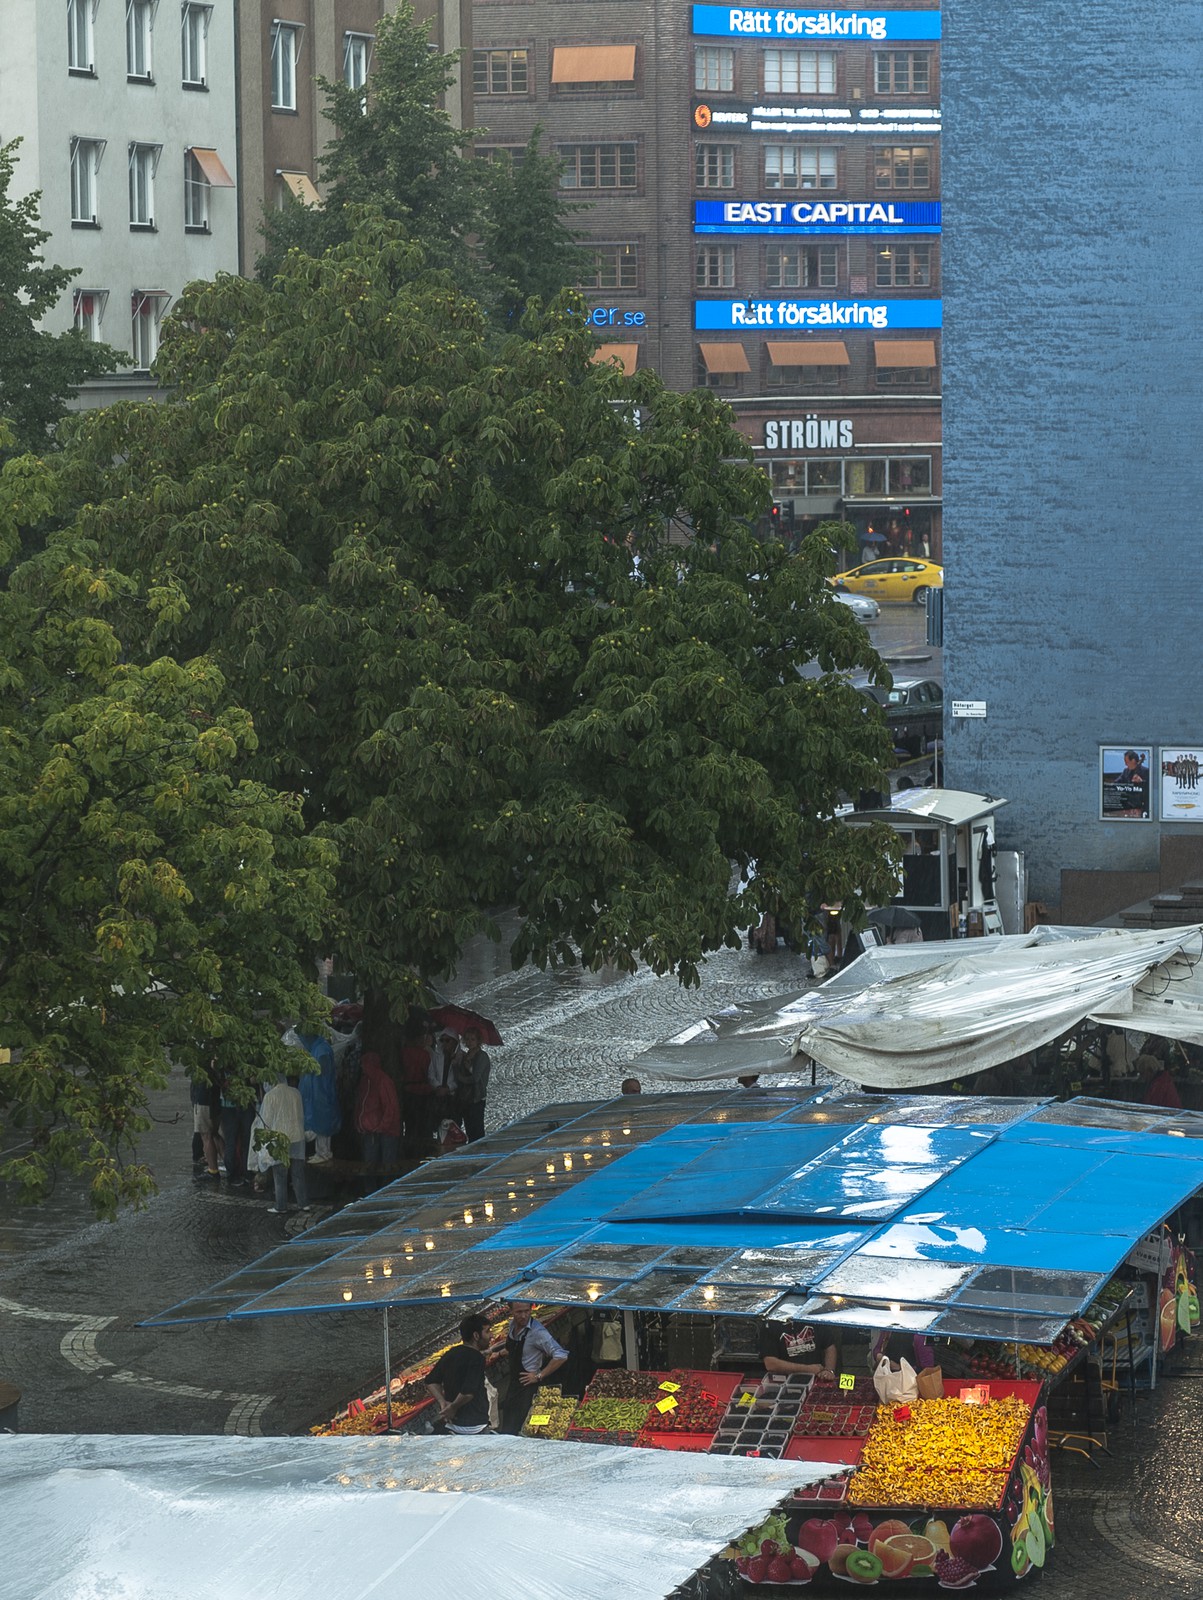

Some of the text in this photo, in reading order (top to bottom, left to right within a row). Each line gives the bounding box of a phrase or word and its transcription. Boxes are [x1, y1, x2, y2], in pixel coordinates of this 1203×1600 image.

[729, 9, 887, 40] Rätt försäkring
[724, 203, 904, 223] EAST CAPITAL
[777, 302, 888, 329] försäkring
[765, 414, 854, 450] STRÖMS
[841, 1377, 854, 1387] 20
